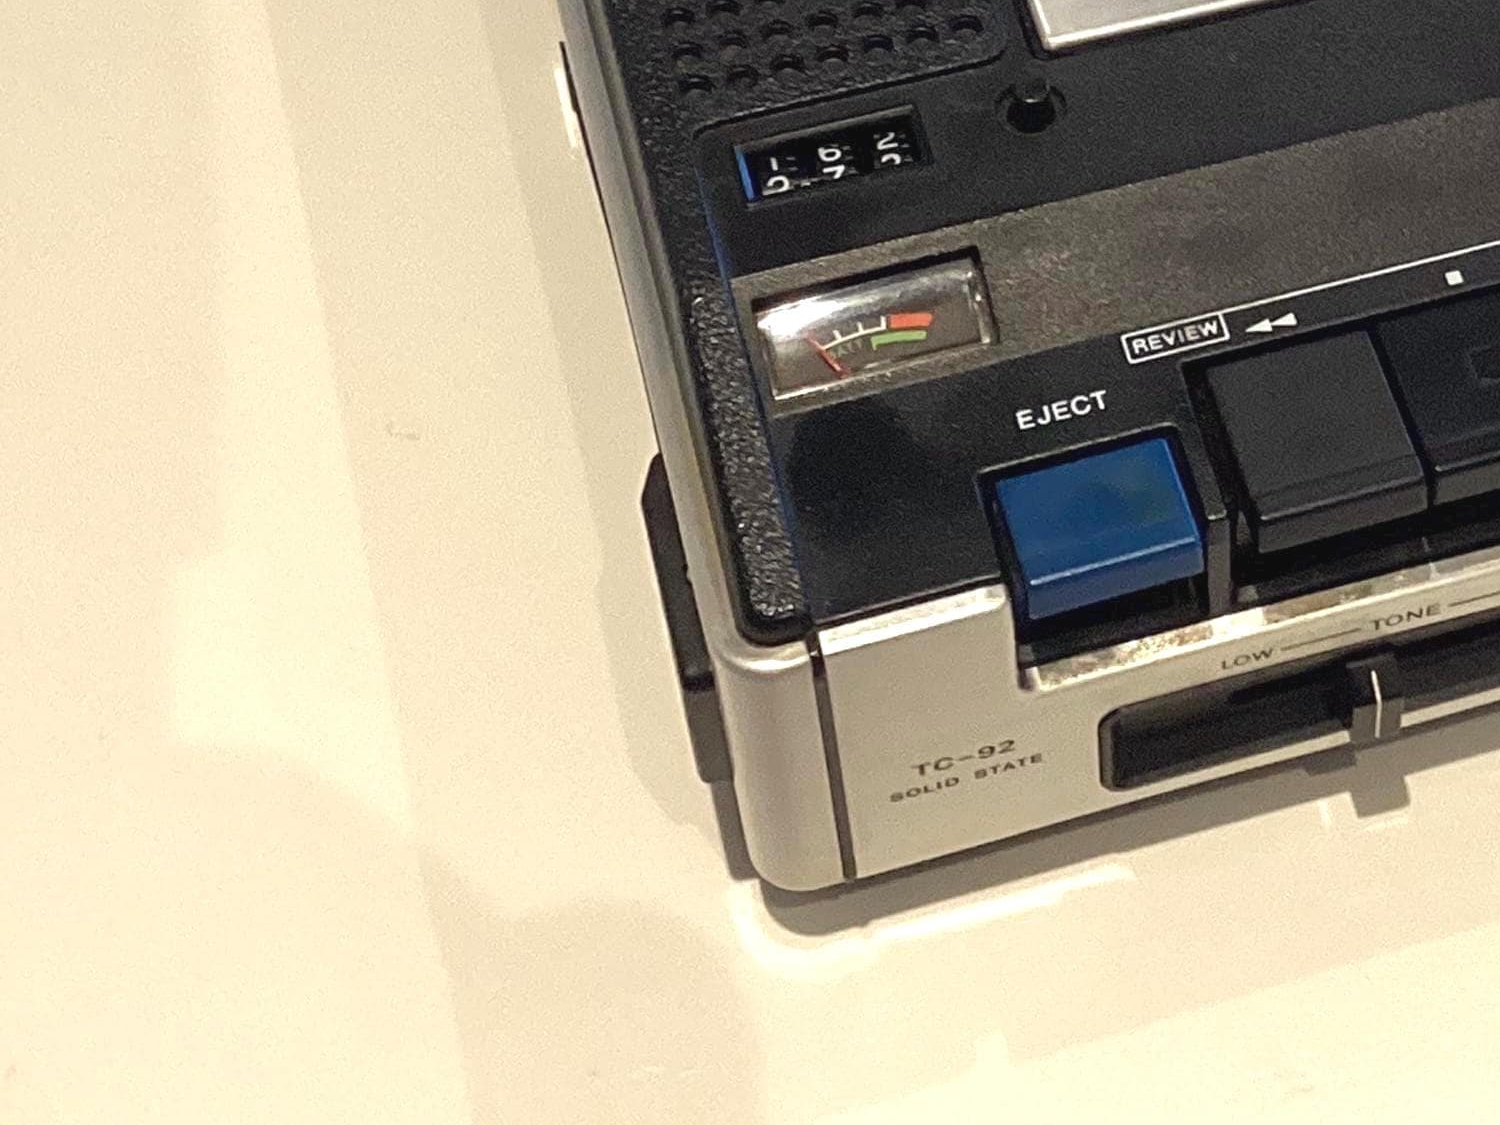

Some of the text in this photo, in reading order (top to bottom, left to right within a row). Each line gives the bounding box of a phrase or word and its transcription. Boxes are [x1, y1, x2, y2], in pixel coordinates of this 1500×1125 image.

[1131, 321, 1219, 355] REVIEW
[1015, 390, 1107, 431] EJECT
[1221, 646, 1275, 671] LOW
[1369, 602, 1444, 633] TONE
[889, 753, 1043, 803] SOLID STATE
[911, 739, 1016, 777] TC-92
